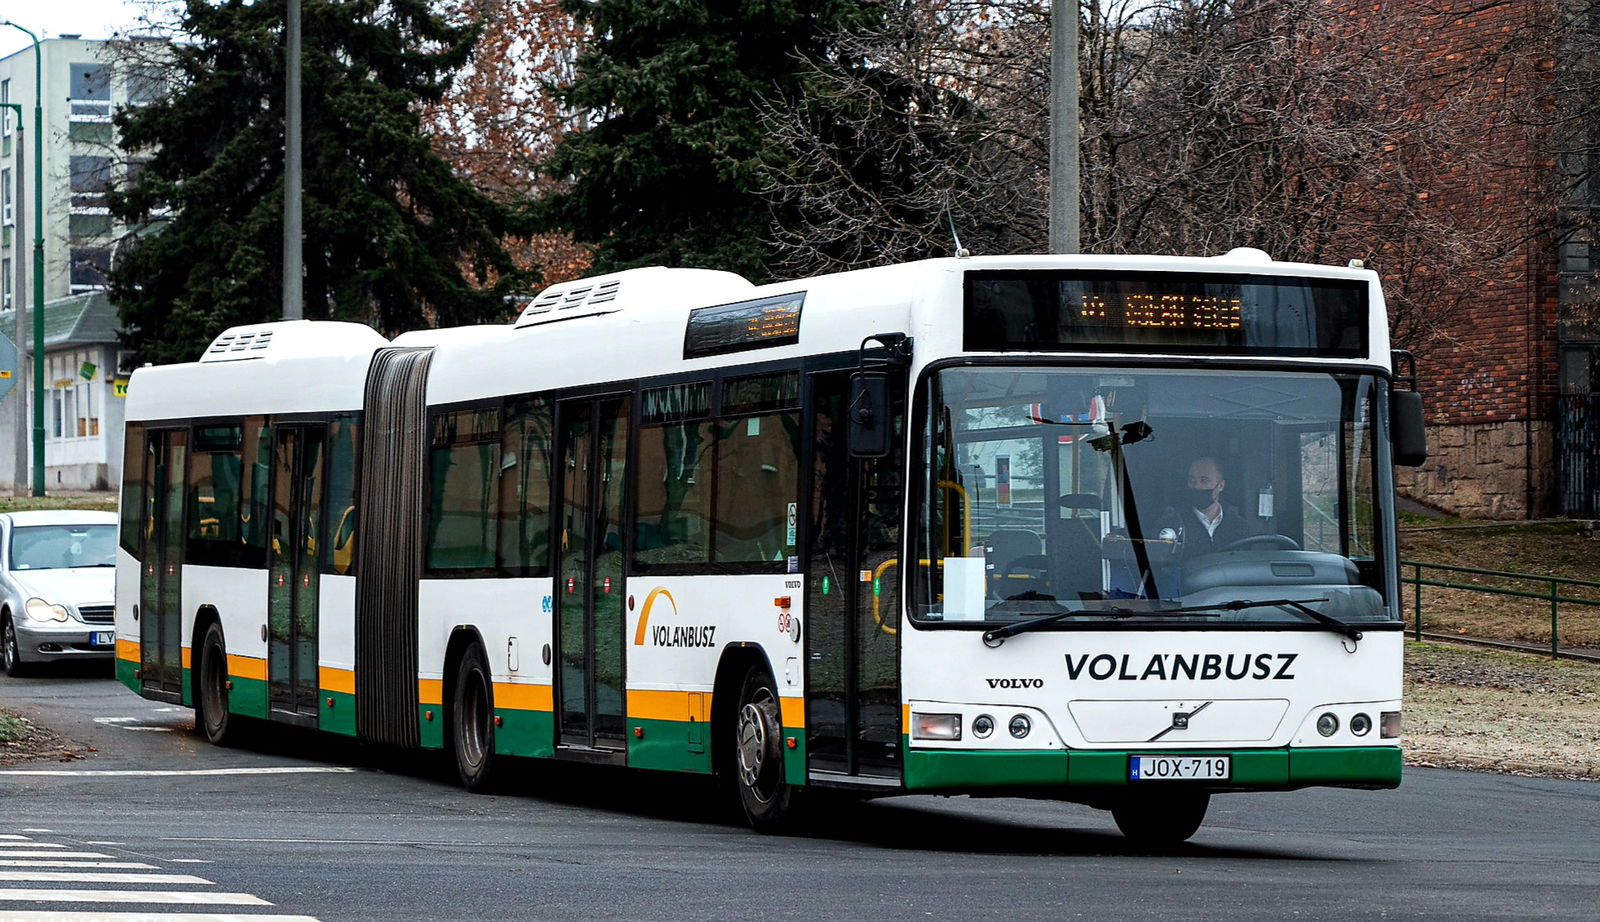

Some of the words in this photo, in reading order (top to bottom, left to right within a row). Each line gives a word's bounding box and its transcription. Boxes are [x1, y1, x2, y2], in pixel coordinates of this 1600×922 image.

[652, 625, 716, 648] VOLÁNBUSZ
[1064, 653, 1299, 681] VOLÁNBUSZ
[985, 678, 1044, 689] VOLVO
[1143, 759, 1225, 777] JOX-719
